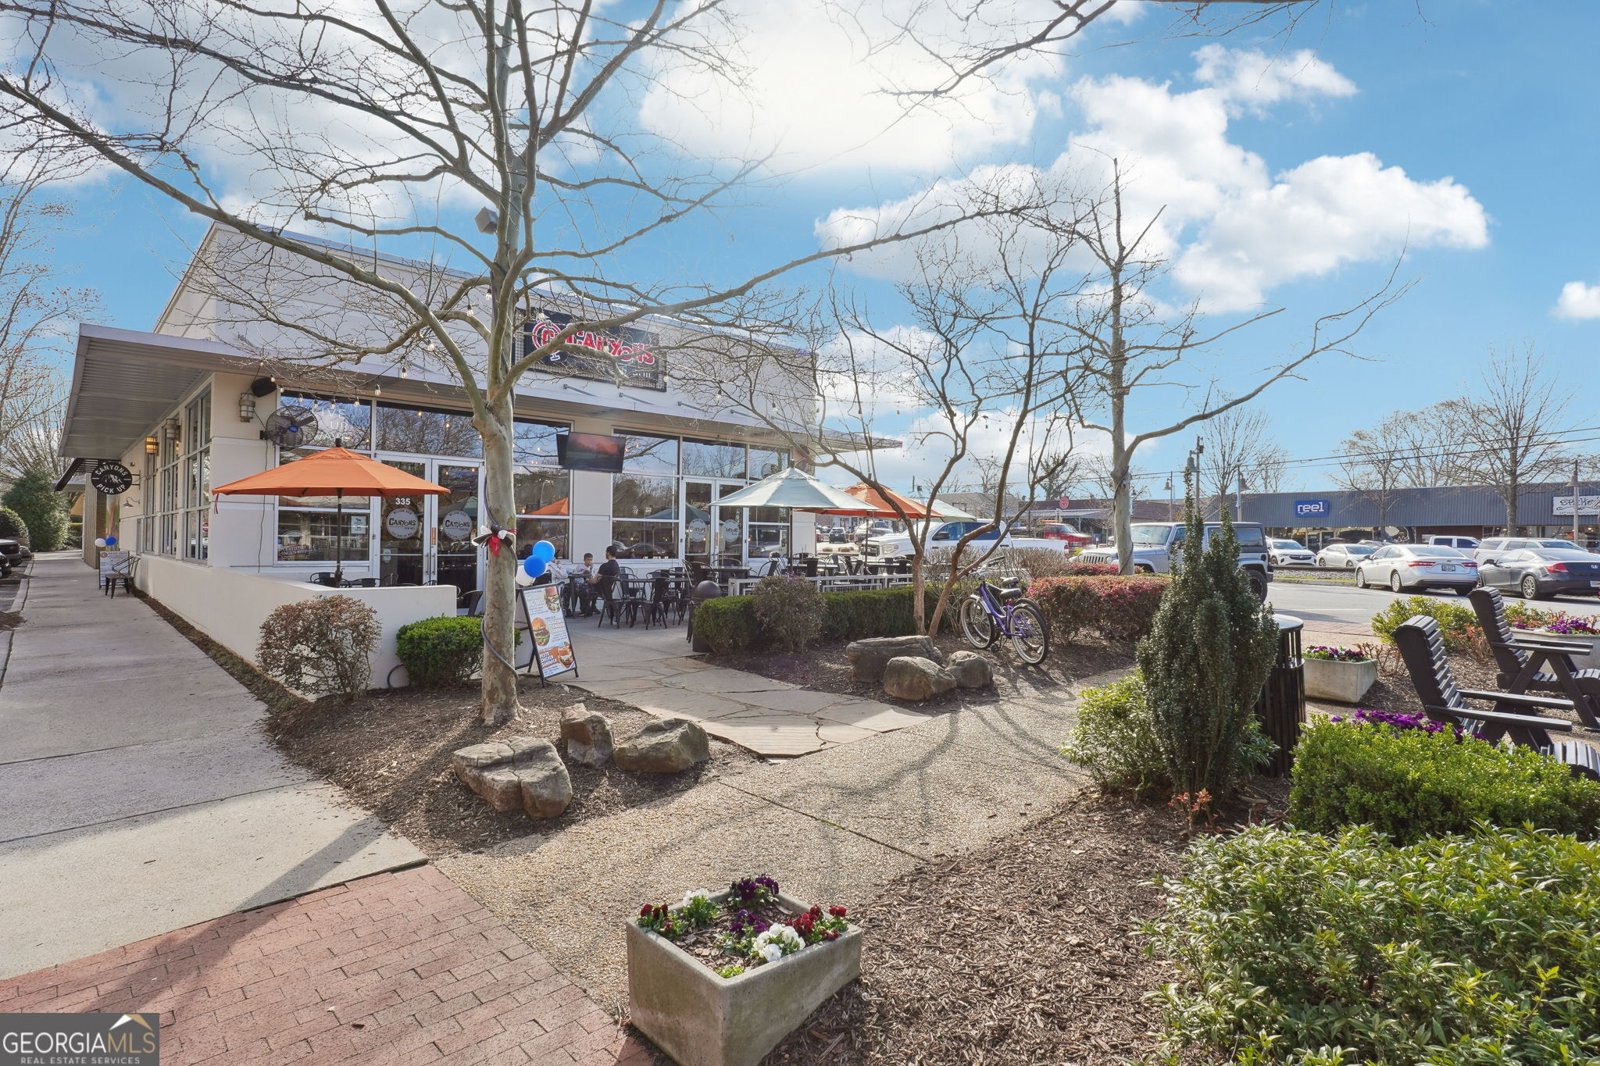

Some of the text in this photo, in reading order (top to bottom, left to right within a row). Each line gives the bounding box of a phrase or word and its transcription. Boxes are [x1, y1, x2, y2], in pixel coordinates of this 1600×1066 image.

[95, 464, 128, 476] CANYONS
[96, 484, 127, 493] PICK UP
[395, 497, 411, 506] 335
[1297, 501, 1325, 513] reel
